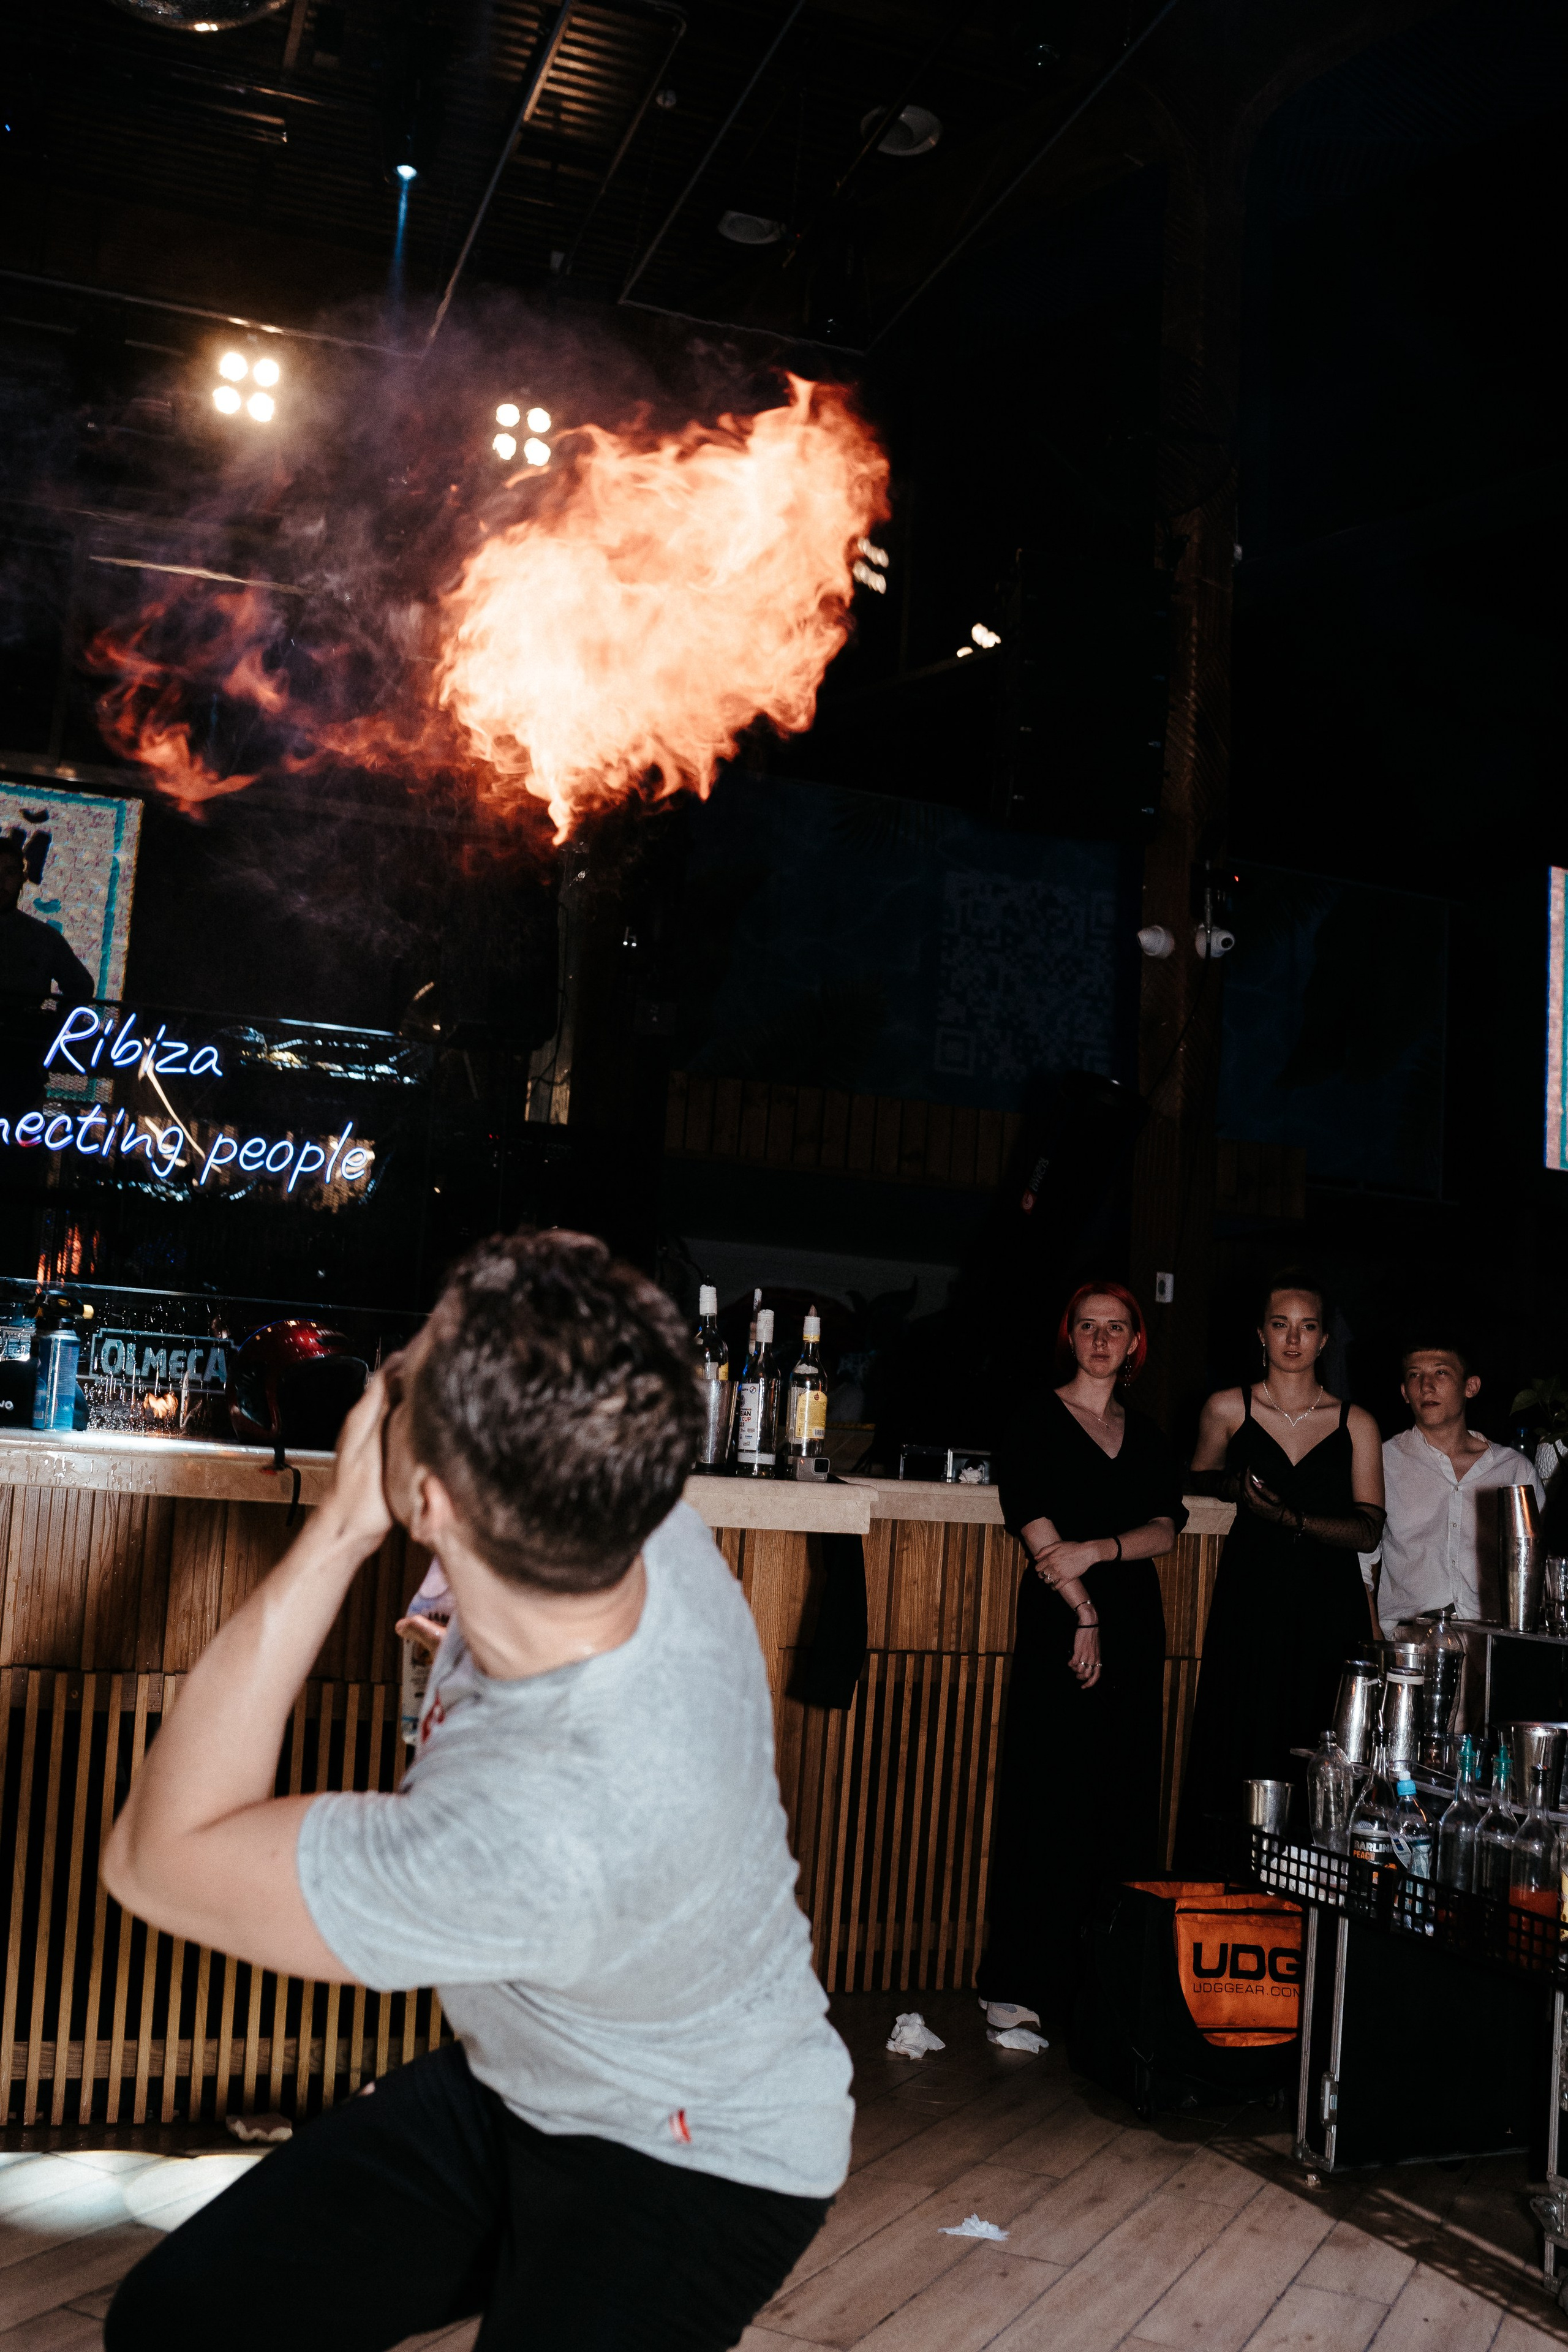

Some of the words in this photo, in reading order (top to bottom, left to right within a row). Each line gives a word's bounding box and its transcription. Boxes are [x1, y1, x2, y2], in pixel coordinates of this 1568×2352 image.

[43, 1006, 223, 1077] Ribiza
[199, 1121, 370, 1193] people
[100, 1338, 228, 1383] OLMECA
[1193, 1942, 1302, 1985] UDG
